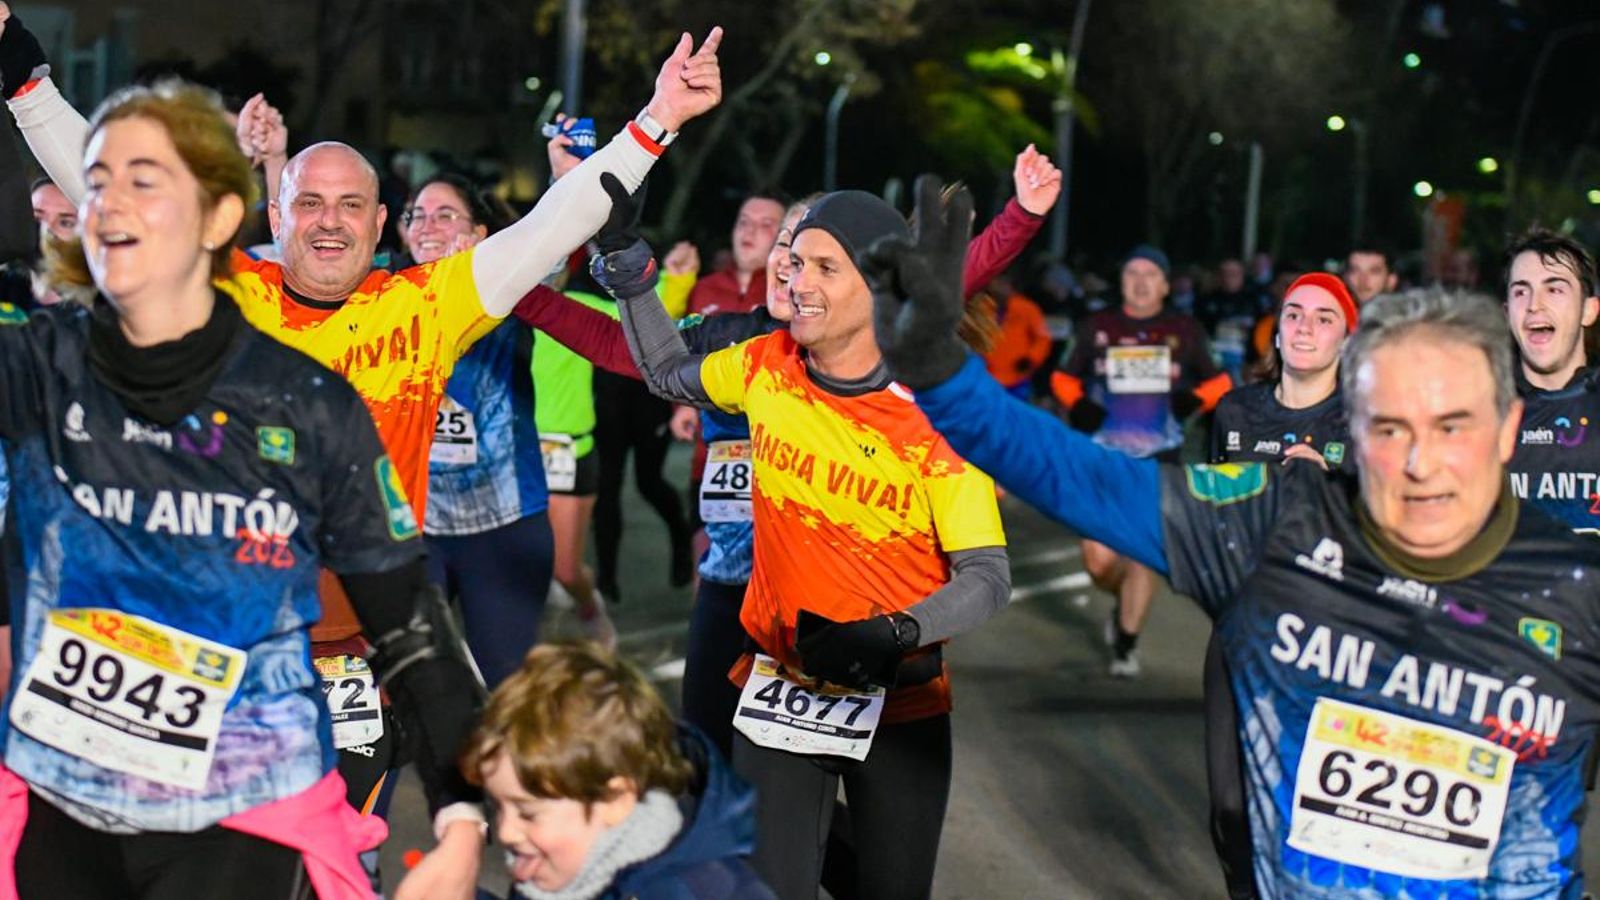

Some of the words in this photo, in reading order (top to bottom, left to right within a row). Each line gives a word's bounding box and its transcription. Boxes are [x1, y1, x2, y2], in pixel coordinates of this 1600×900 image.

[332, 314, 420, 376] VIVA!
[435, 411, 467, 435] 25
[1521, 426, 1554, 444] jaén
[710, 463, 749, 490] 48
[753, 422, 816, 486] ANSIA
[826, 459, 915, 519] VIVA!
[1536, 472, 1600, 499] ANT
[145, 487, 299, 543] ANTÓN
[91, 612, 123, 641] 42
[52, 638, 208, 729] 9943
[753, 678, 873, 726] 4677
[1270, 612, 1376, 689] SAN
[1380, 674, 1566, 746] ANTÓN
[1318, 750, 1483, 827] 6290
